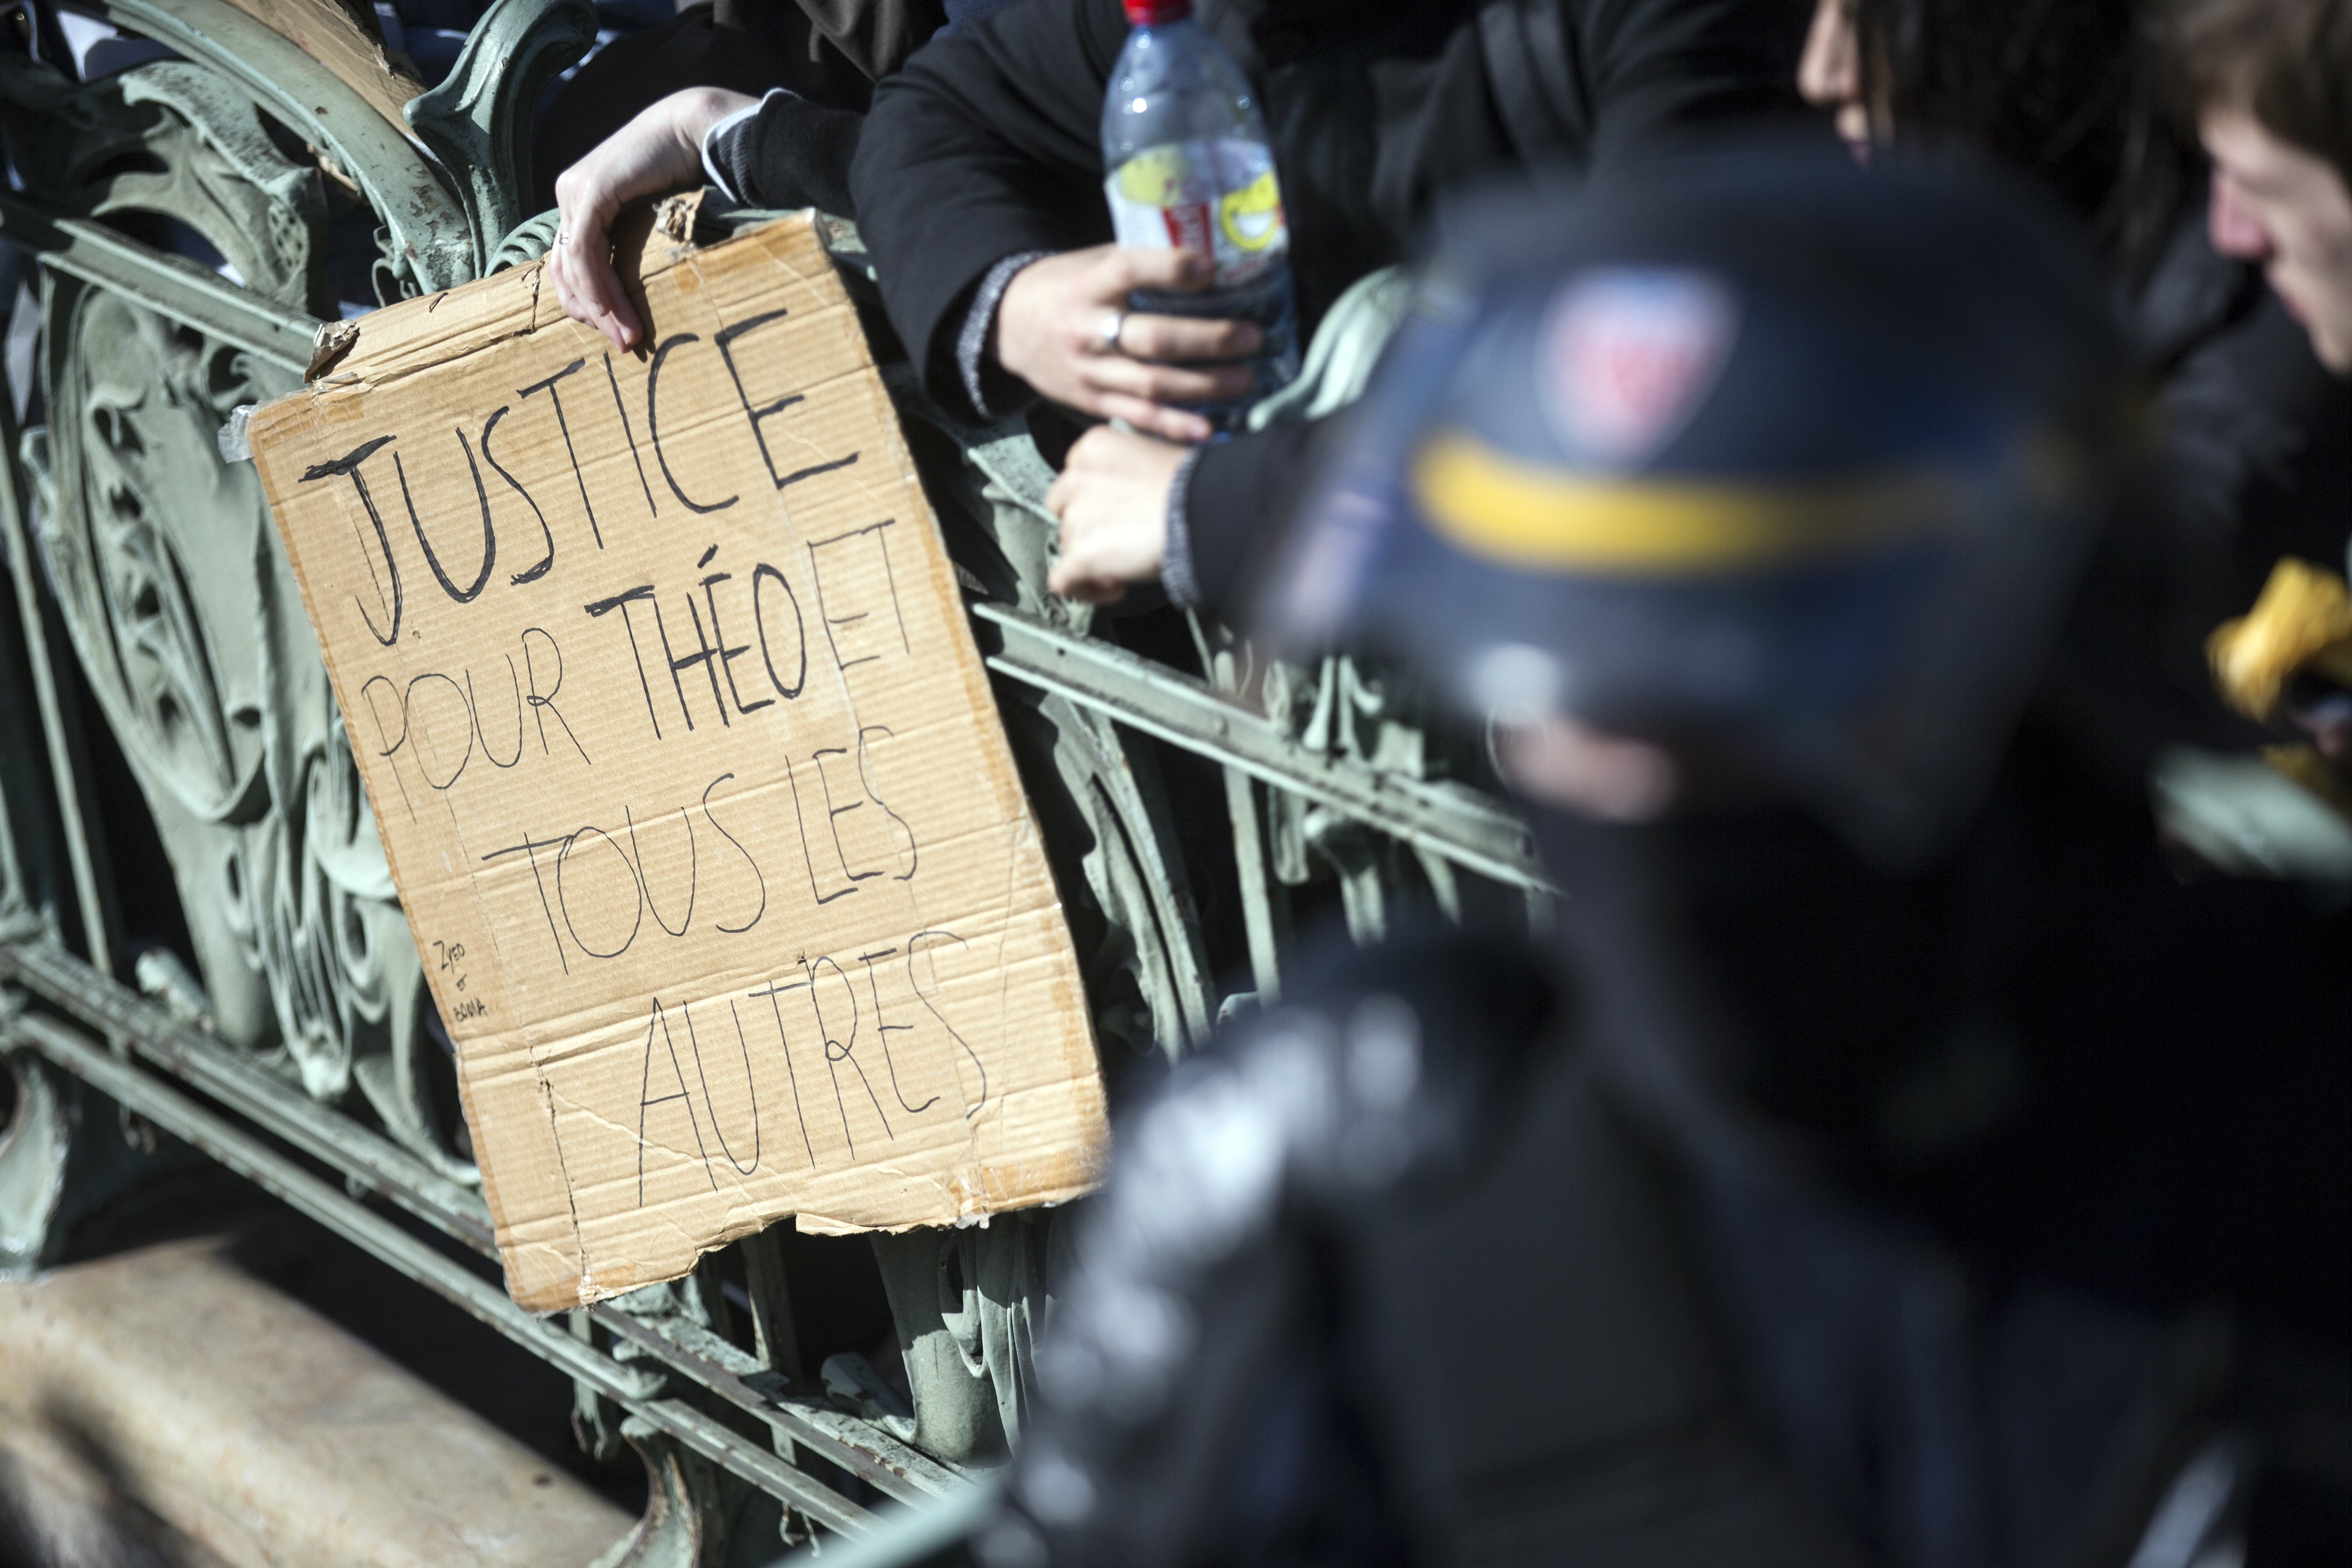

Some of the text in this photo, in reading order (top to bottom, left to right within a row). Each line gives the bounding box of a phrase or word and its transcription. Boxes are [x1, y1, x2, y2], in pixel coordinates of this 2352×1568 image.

[299, 309, 858, 646] JUSTICE
[361, 518, 913, 824] POUR THÉO ET
[482, 725, 918, 976] TOUS LES
[639, 931, 987, 1208] AUTRES
